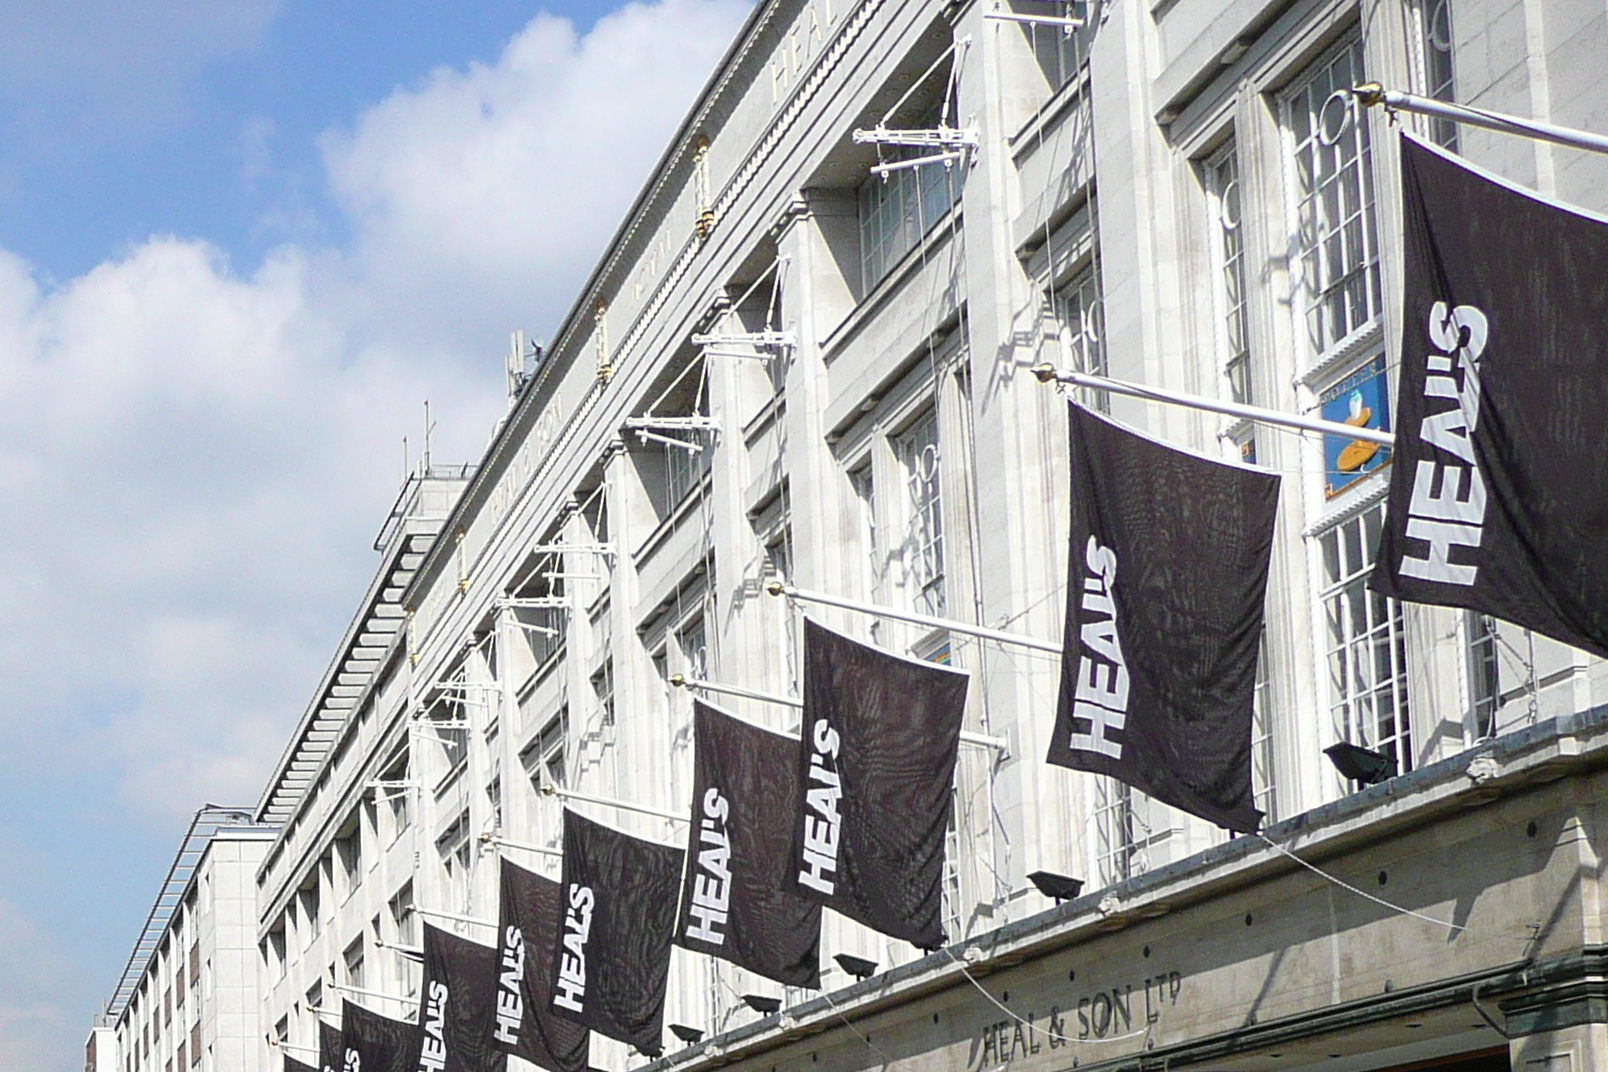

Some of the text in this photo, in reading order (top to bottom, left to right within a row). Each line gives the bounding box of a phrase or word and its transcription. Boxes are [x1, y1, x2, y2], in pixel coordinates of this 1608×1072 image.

[1398, 300, 1489, 586] HEAL'S
[1069, 534, 1130, 760] HEAL'S
[685, 787, 732, 945] HEAL'S
[798, 718, 842, 895] HEAL'S
[493, 925, 526, 1045] HEAL'S
[553, 883, 595, 1013] HEAL'S
[982, 1012, 1041, 1068] HEAL
[1048, 1005, 1066, 1050] &
[1078, 984, 1132, 1043] SON
